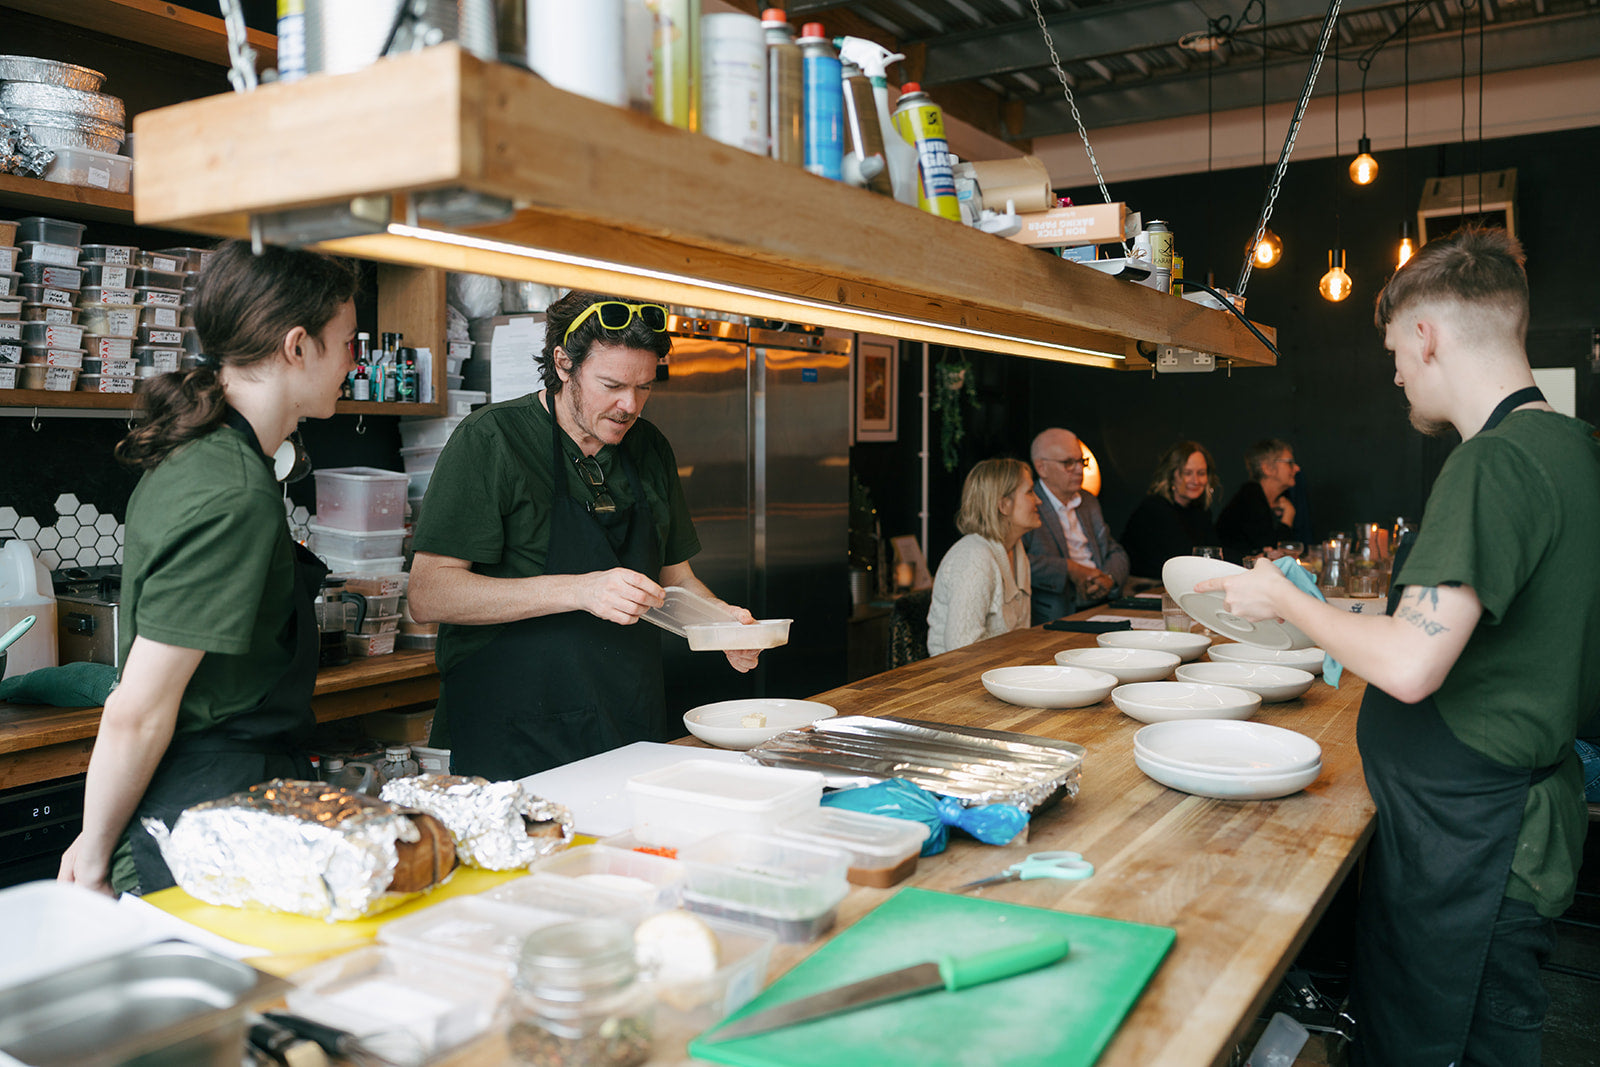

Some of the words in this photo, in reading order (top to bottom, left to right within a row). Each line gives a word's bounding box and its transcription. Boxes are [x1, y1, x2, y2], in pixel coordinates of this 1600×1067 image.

[1028, 220, 1057, 231] PAPER
[1059, 217, 1095, 230] BAKING
[1036, 228, 1064, 239] STICK
[1066, 227, 1087, 236] NON
